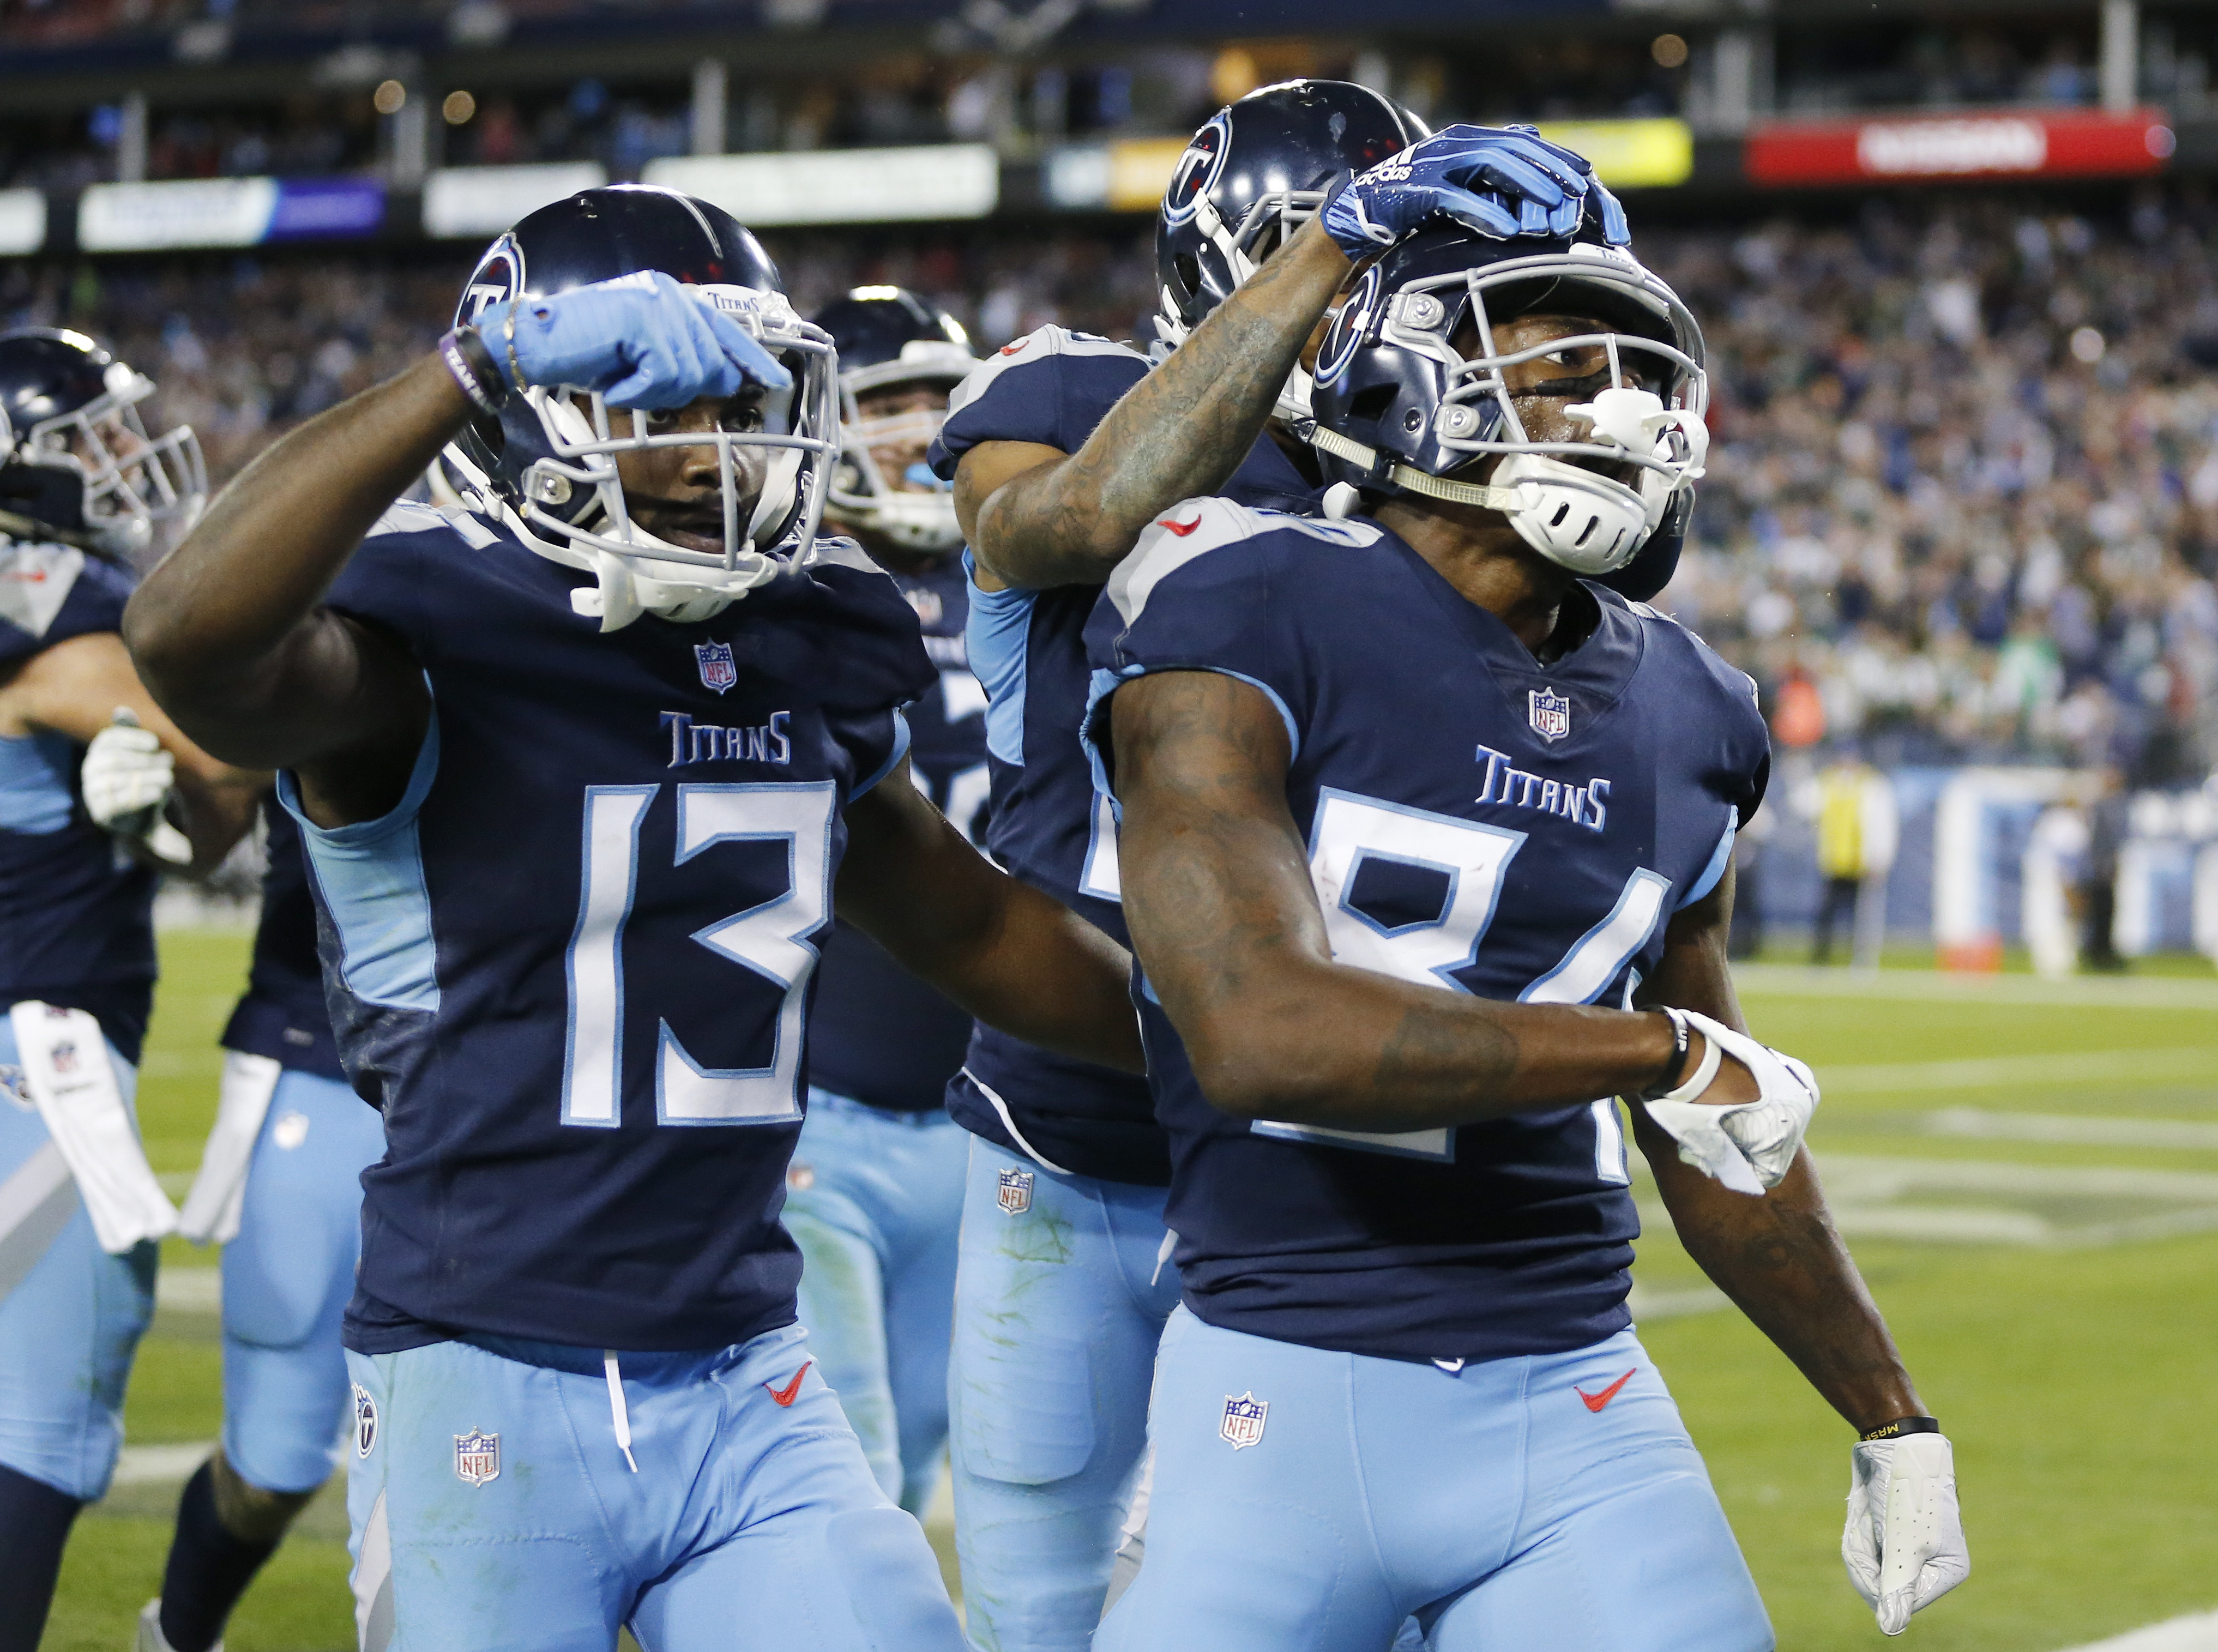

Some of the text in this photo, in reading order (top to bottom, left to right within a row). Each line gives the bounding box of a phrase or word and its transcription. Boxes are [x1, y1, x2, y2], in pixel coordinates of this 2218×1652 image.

[1355, 164, 1413, 186] addas
[705, 662, 732, 683] NFL
[1538, 710, 1564, 732] NFL
[660, 710, 791, 768] TITANS
[1474, 744, 1611, 833] TITANS
[560, 779, 837, 1129] 13
[1001, 1188, 1025, 1207] NFL
[1226, 1416, 1256, 1439] NFL
[462, 1455, 493, 1476] NFL
